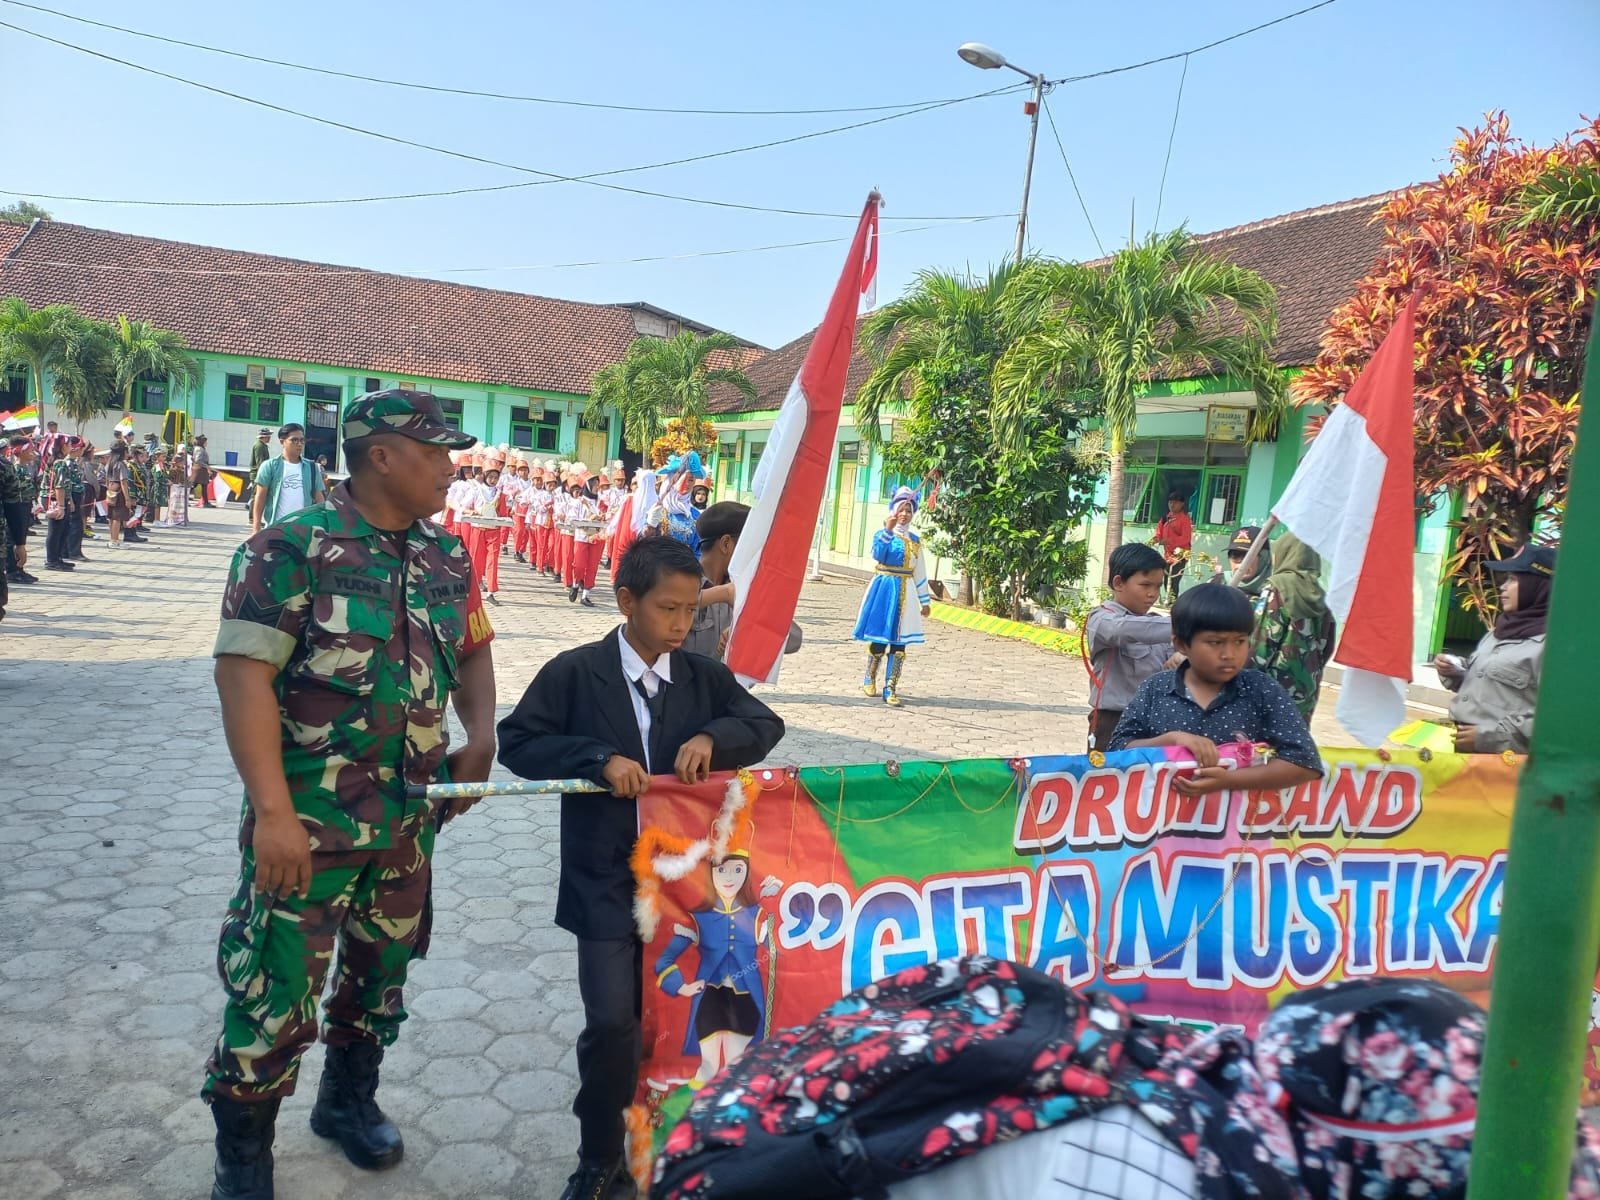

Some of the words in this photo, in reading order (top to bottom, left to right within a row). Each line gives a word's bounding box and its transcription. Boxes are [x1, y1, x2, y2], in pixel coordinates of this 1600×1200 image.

[333, 575, 382, 595] YUDHI
[429, 584, 451, 599] TNI
[1015, 759, 1236, 852] DRUM
[1238, 762, 1422, 838] BAND
